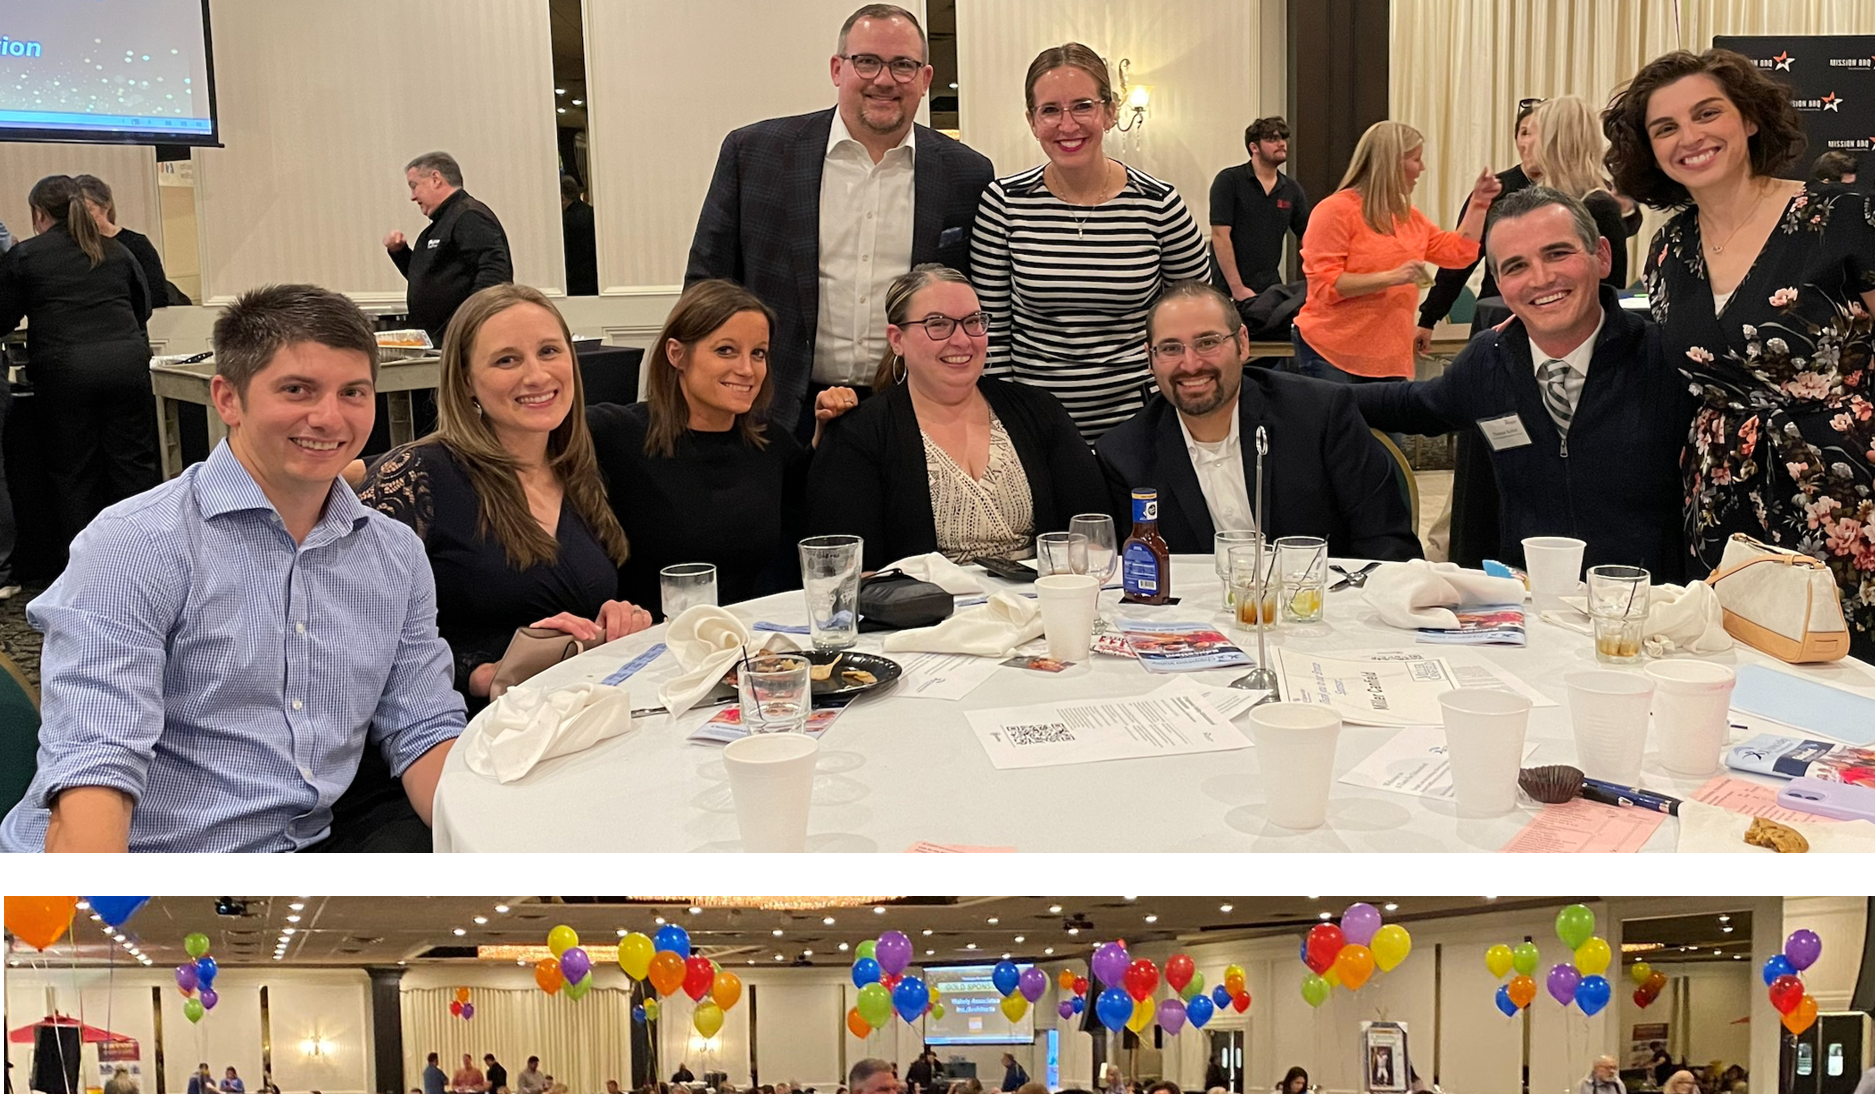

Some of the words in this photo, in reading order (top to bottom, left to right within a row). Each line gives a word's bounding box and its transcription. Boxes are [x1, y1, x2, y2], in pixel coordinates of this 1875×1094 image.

[1829, 58, 1857, 67] MISSION
[1858, 58, 1871, 67] BBQ
[1808, 99, 1821, 108] BBQ
[1827, 140, 1855, 148] MISSION
[1856, 140, 1869, 148] BBQ
